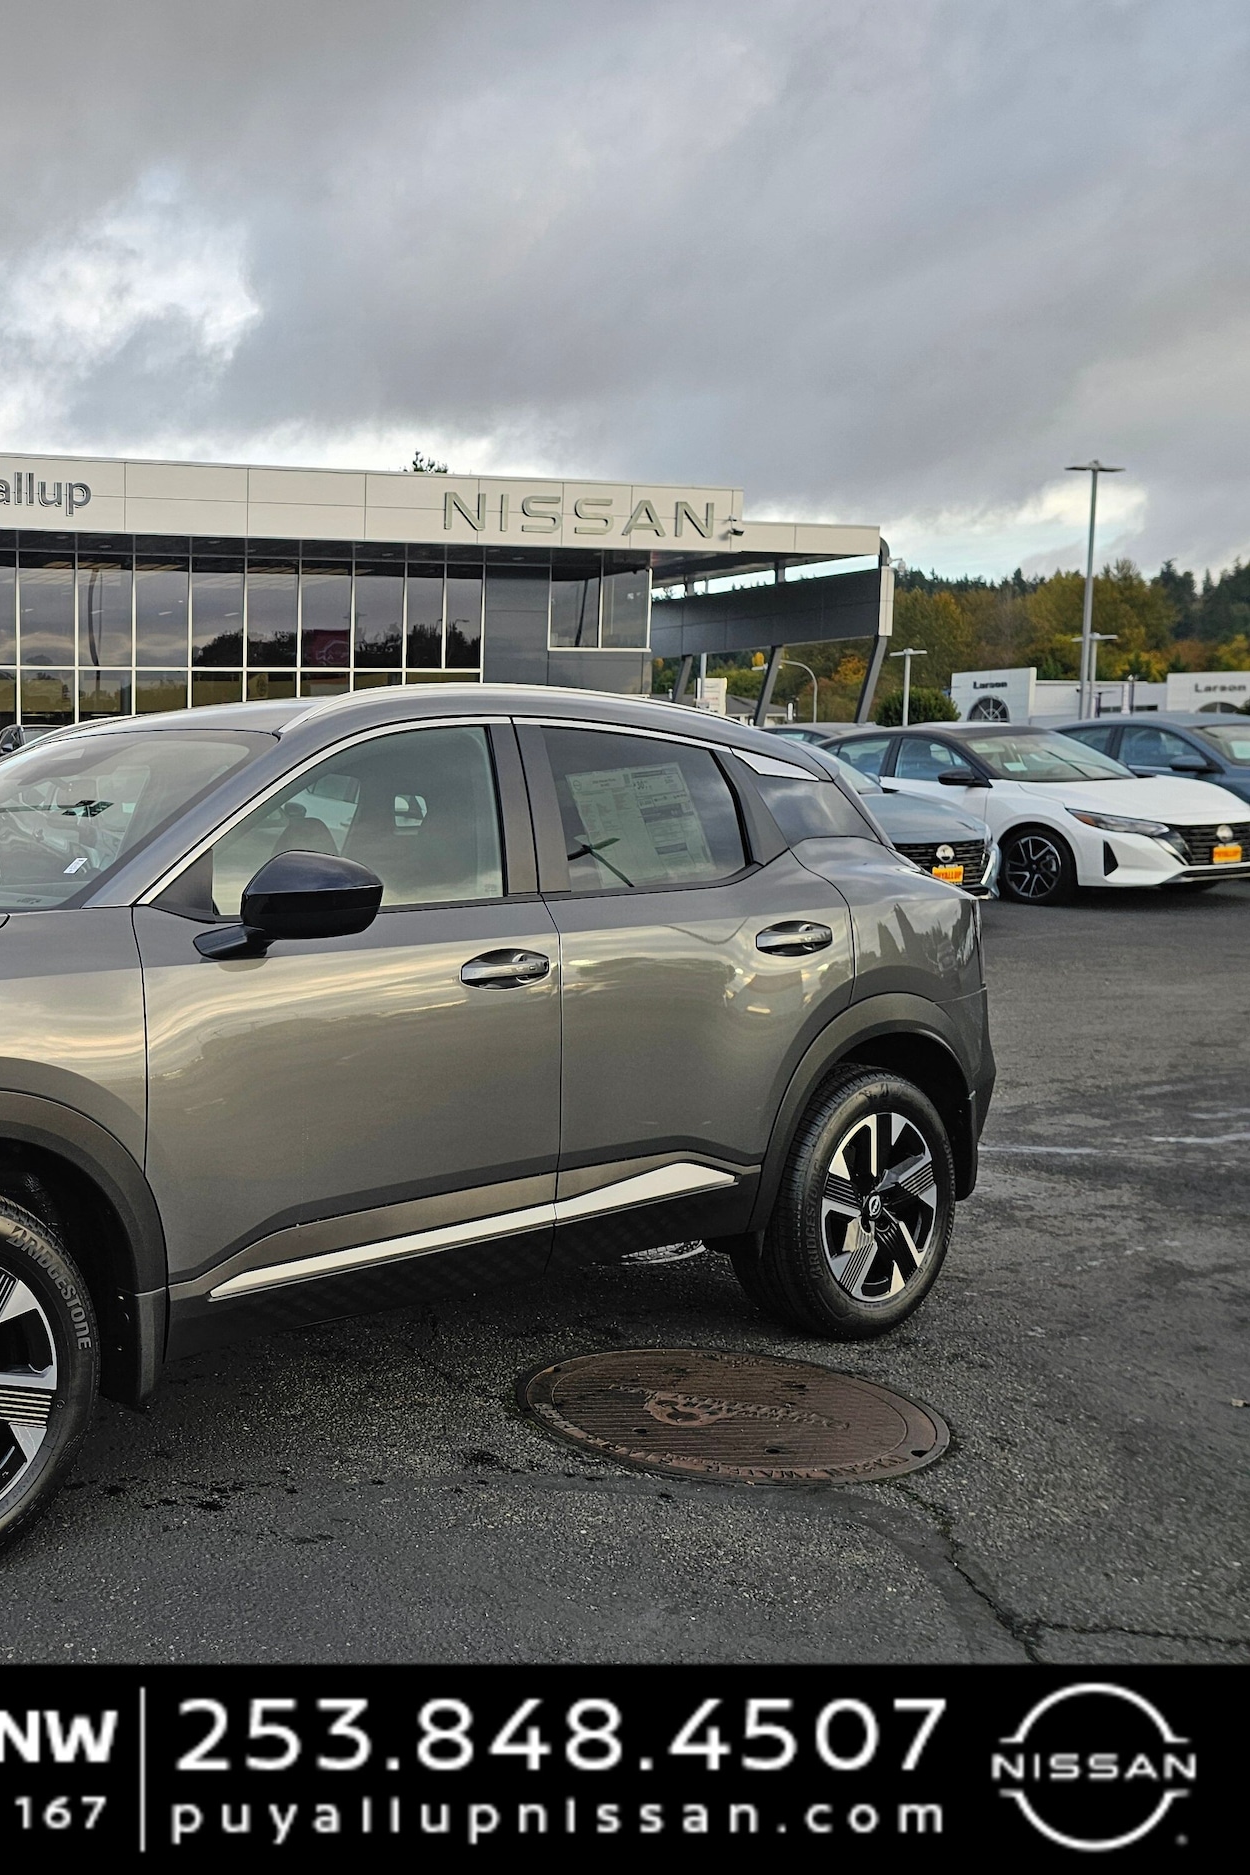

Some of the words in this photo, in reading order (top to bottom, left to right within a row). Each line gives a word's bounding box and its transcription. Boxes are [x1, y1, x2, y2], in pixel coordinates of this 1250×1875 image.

[444, 491, 714, 538] NISSAN
[973, 681, 1008, 689] Larson
[1194, 682, 1247, 693] Larson
[6, 1225, 92, 1350] BRIDGESTONE
